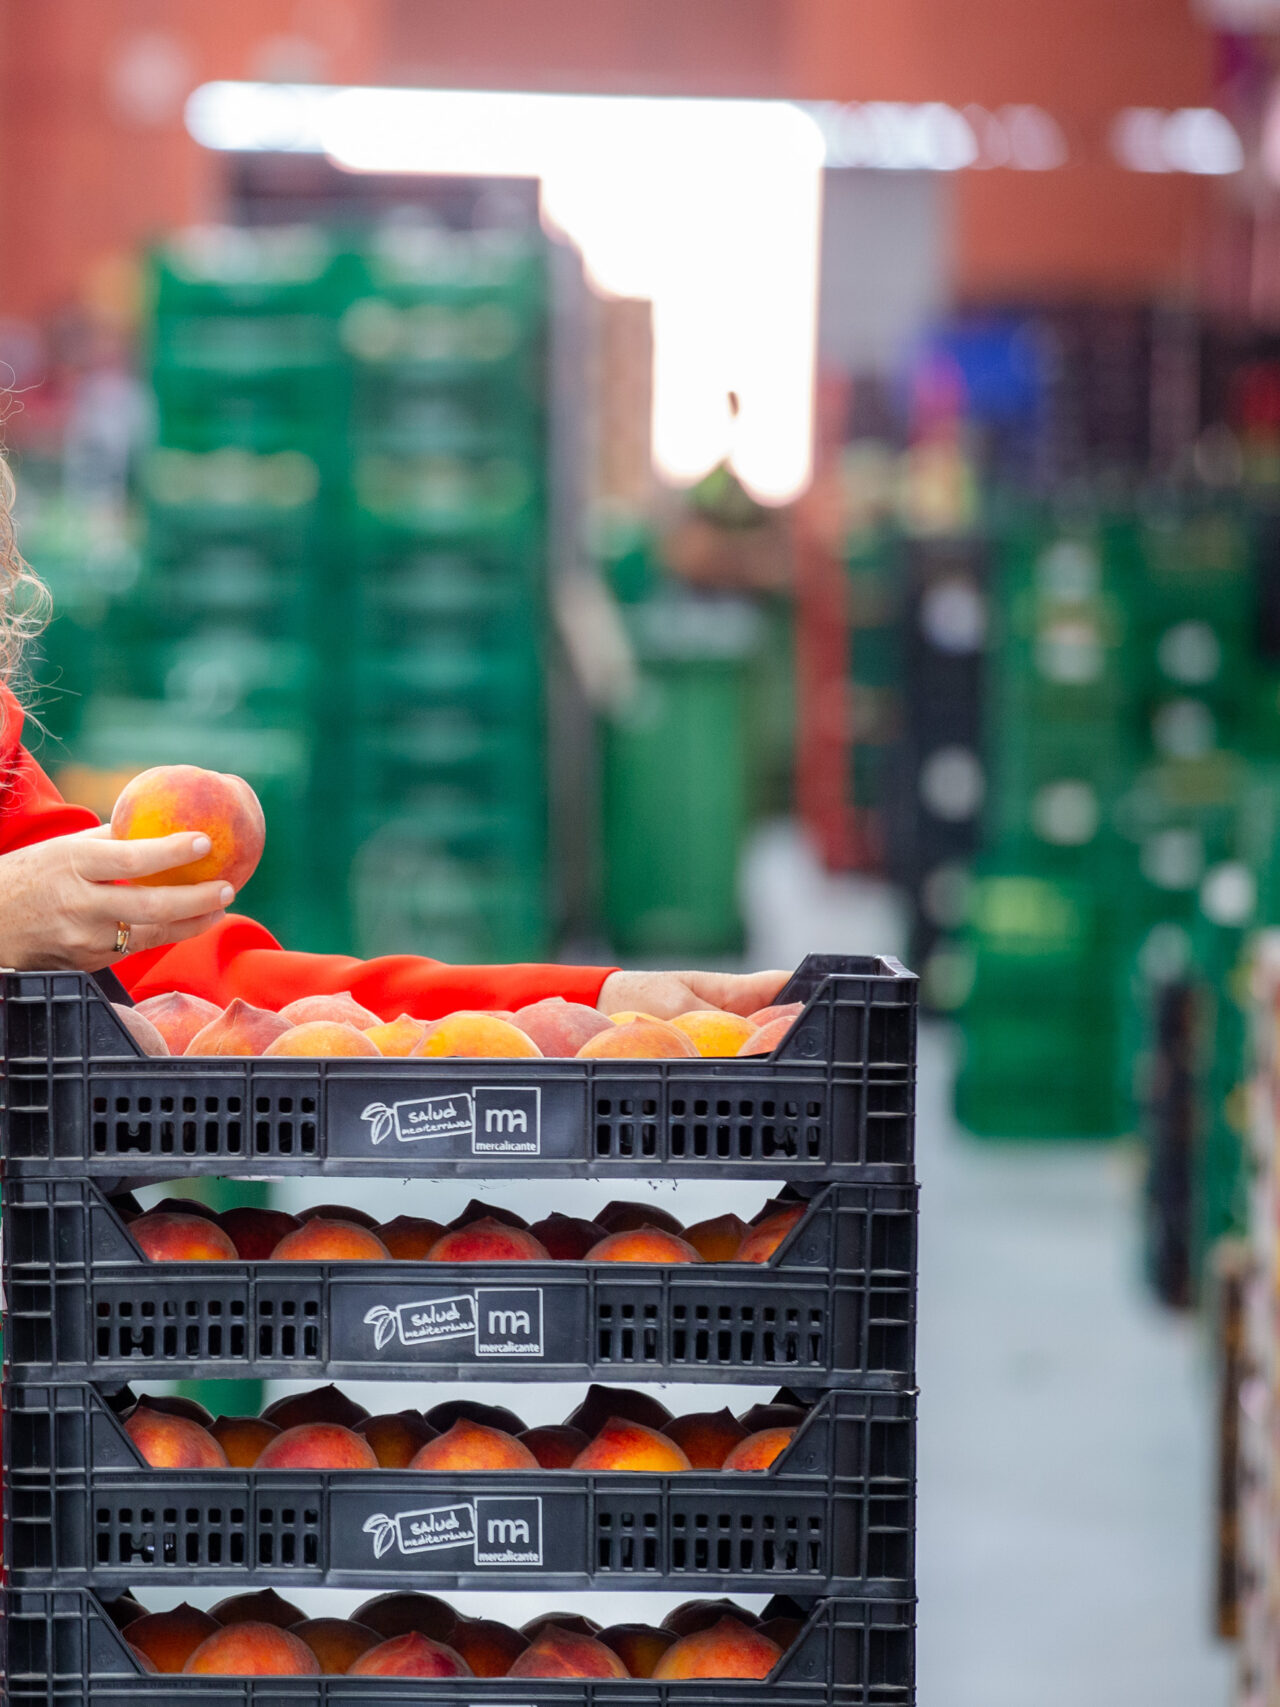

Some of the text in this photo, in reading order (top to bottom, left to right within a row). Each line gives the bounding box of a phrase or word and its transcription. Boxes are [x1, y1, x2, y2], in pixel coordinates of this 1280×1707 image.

[485, 1109, 527, 1132] ma
[476, 1140, 536, 1151] mercalicante
[488, 1310, 530, 1334] ma
[479, 1341, 540, 1352] mercalicante
[487, 1519, 529, 1543] ma
[478, 1550, 539, 1561] mercalicante
